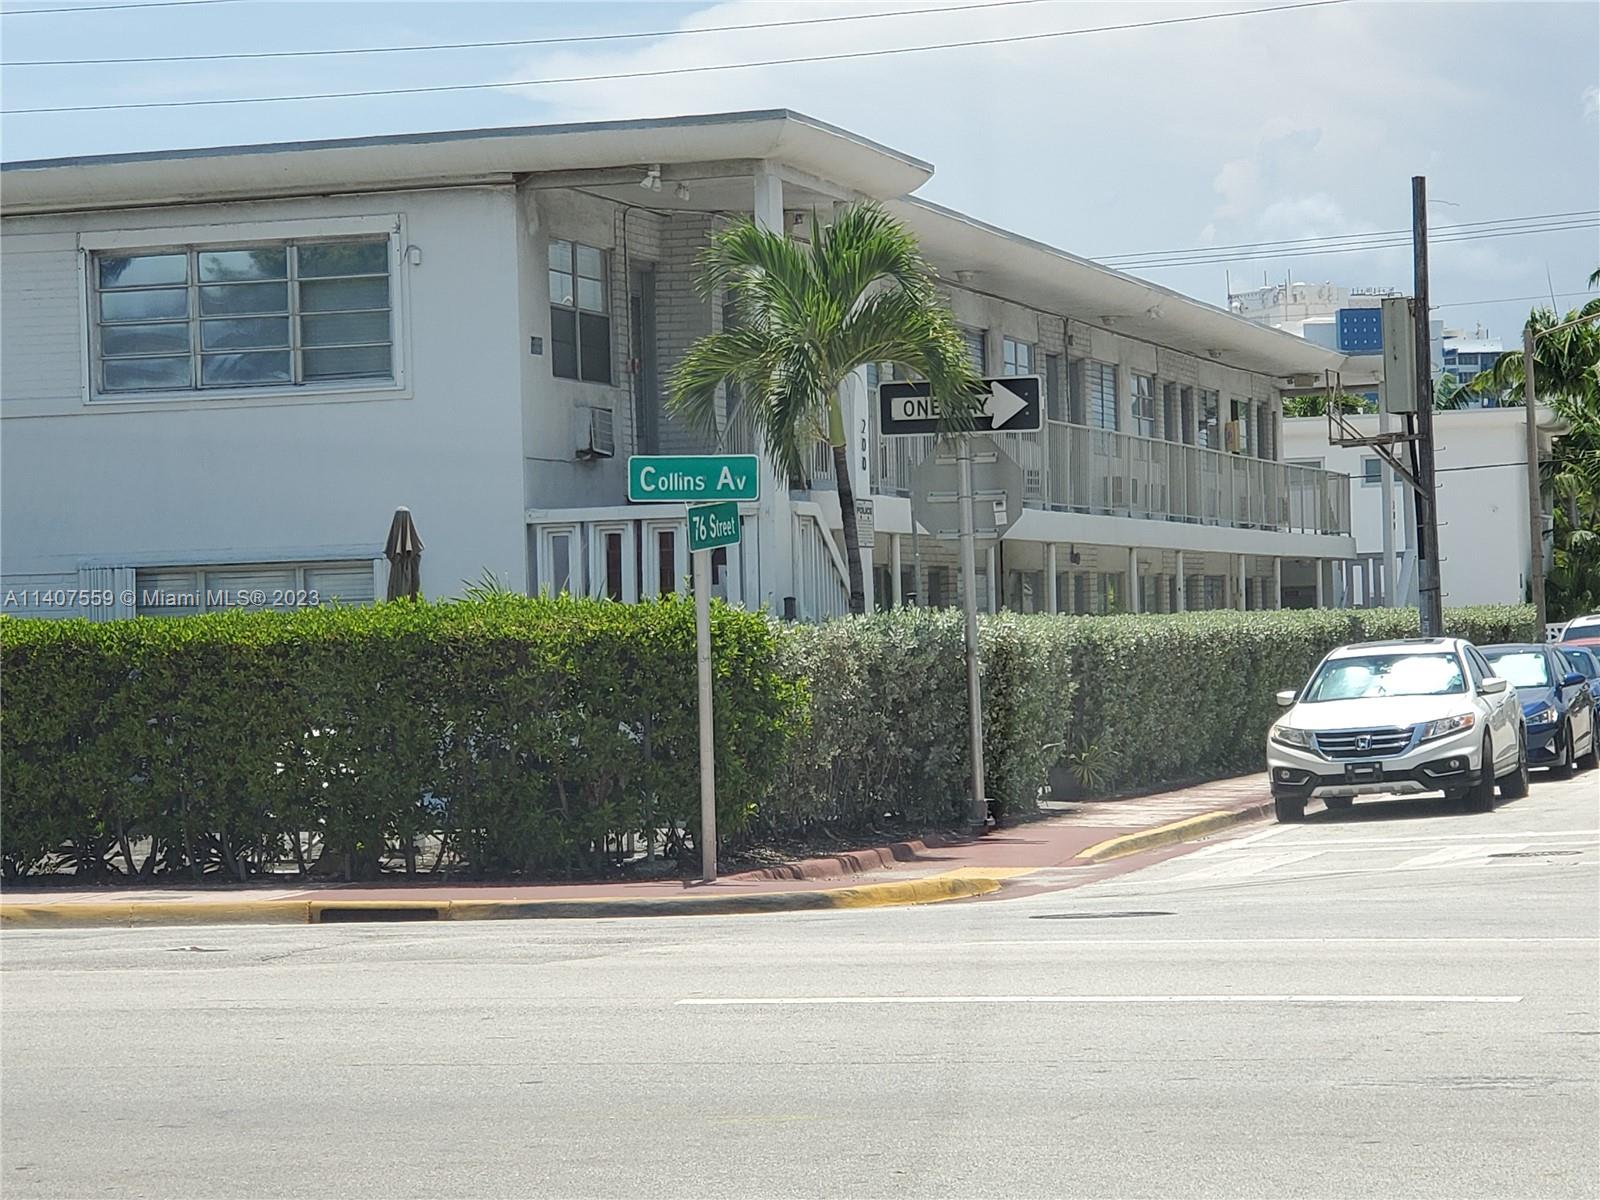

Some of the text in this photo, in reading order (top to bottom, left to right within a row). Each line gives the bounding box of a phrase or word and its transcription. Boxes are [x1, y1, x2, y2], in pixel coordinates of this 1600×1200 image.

[903, 400, 940, 418] ONE
[640, 465, 747, 492] Collins Av
[692, 513, 736, 541] 76 Street
